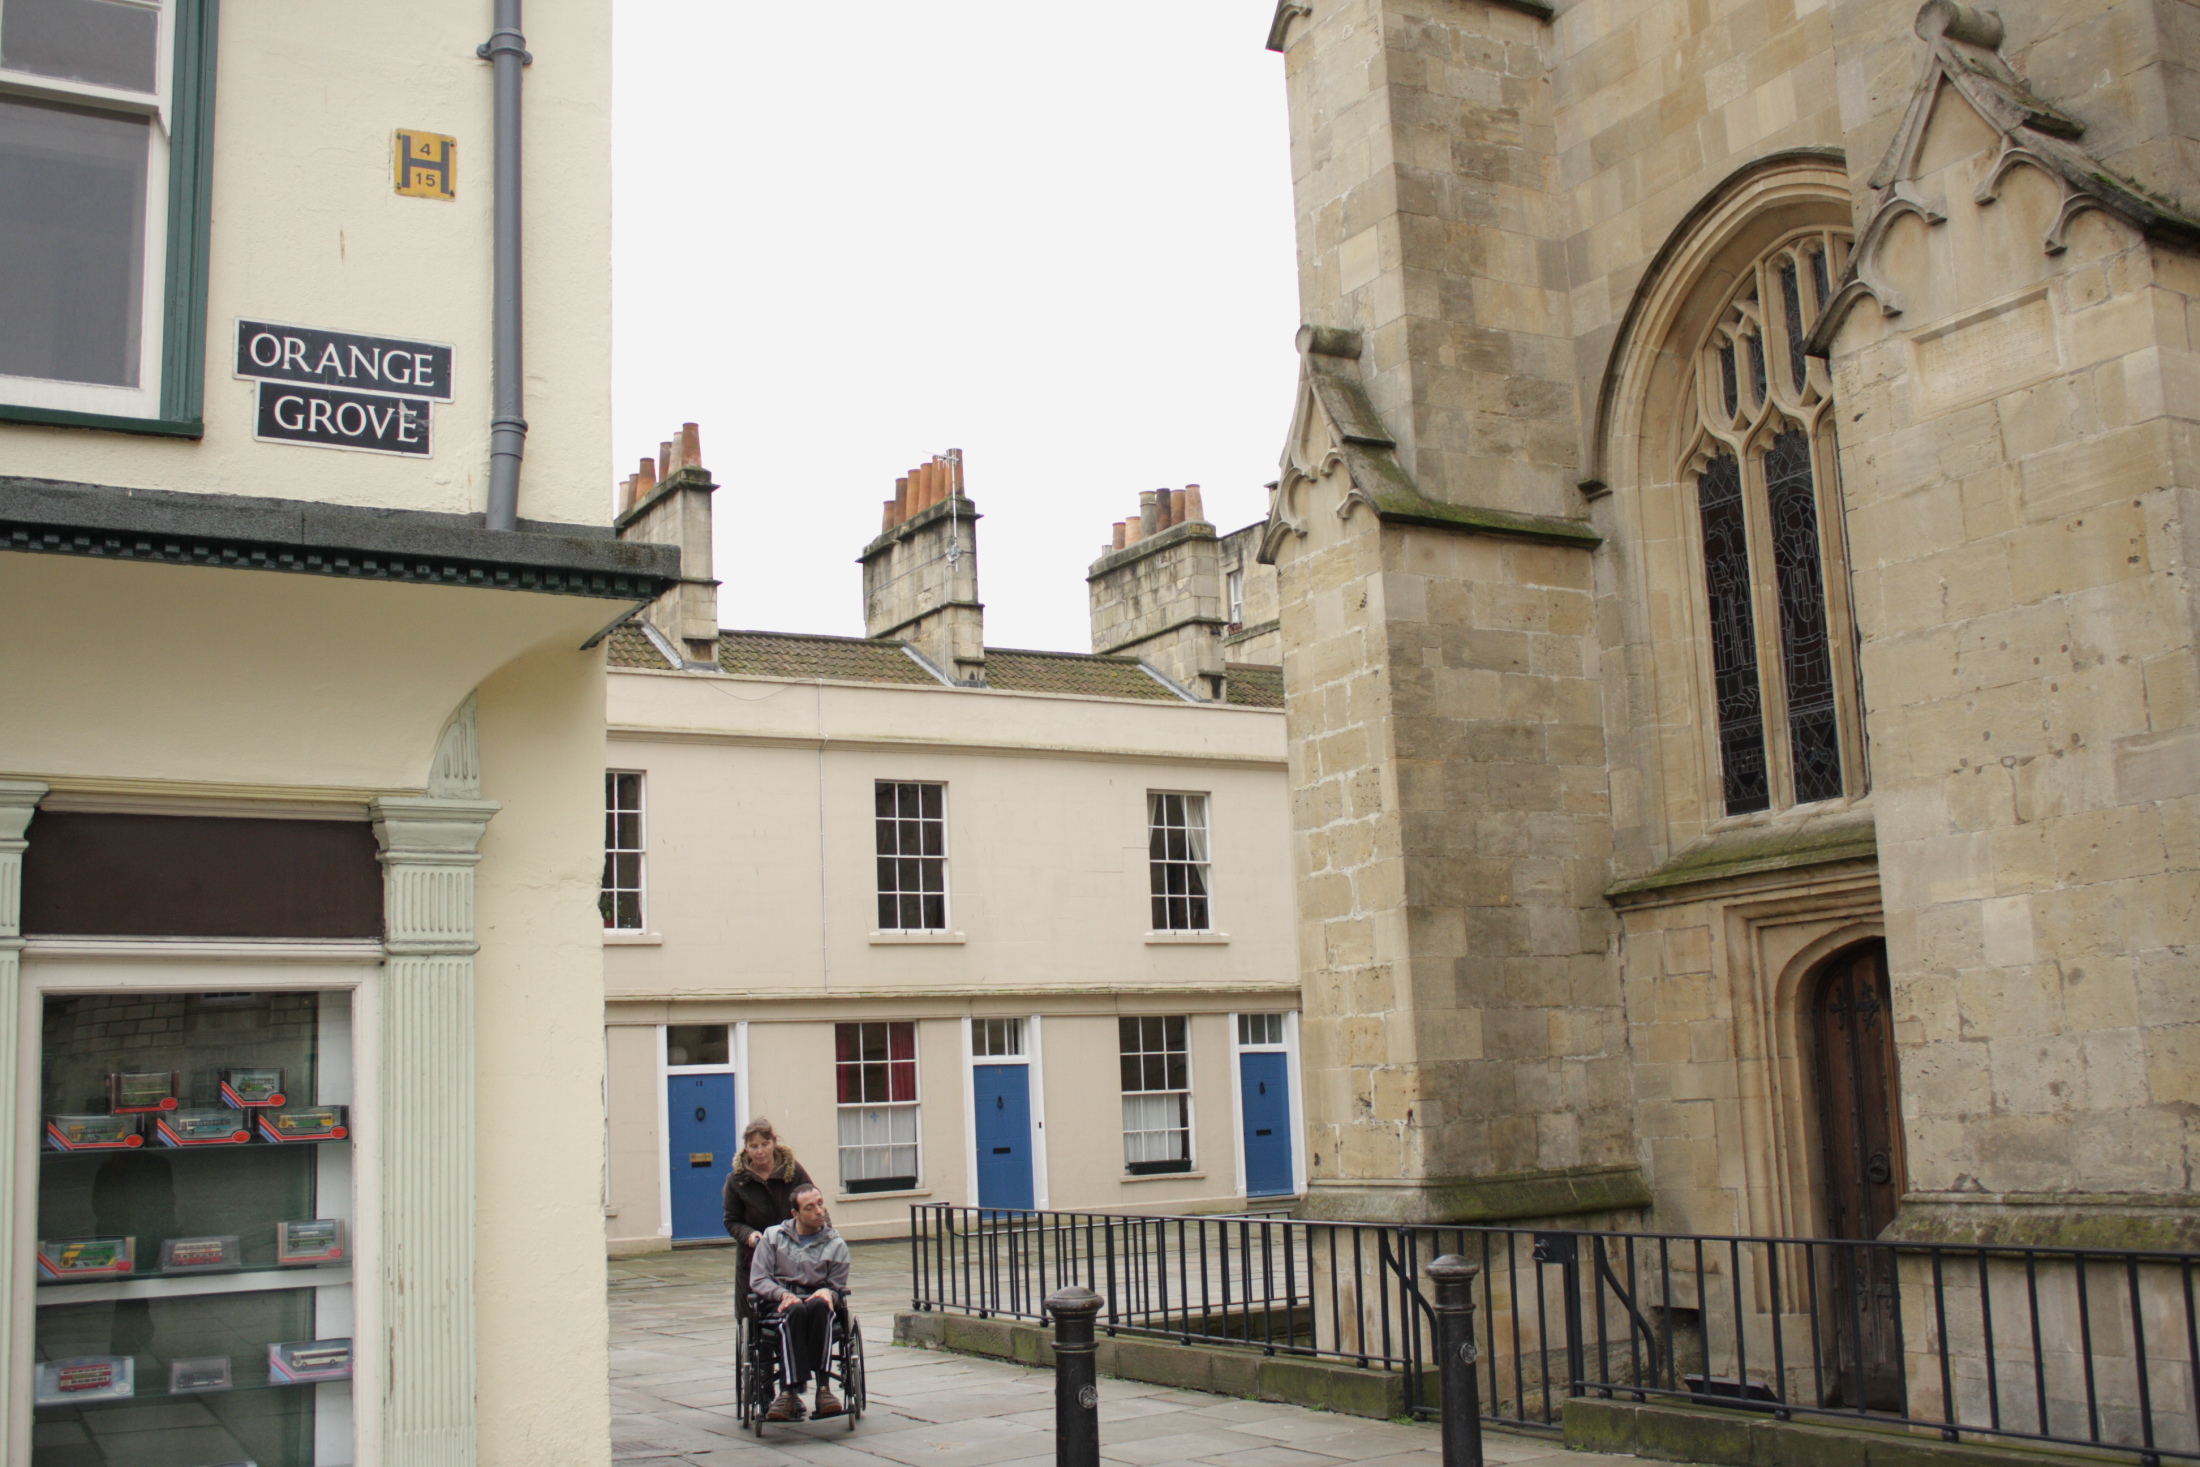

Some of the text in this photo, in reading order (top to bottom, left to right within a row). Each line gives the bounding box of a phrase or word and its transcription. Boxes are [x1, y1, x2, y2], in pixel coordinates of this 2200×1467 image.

[401, 134, 450, 195] H
[420, 142, 432, 157] 4
[415, 172, 437, 188] 15
[249, 332, 436, 388] ORANGE
[273, 394, 420, 444] GROVE
